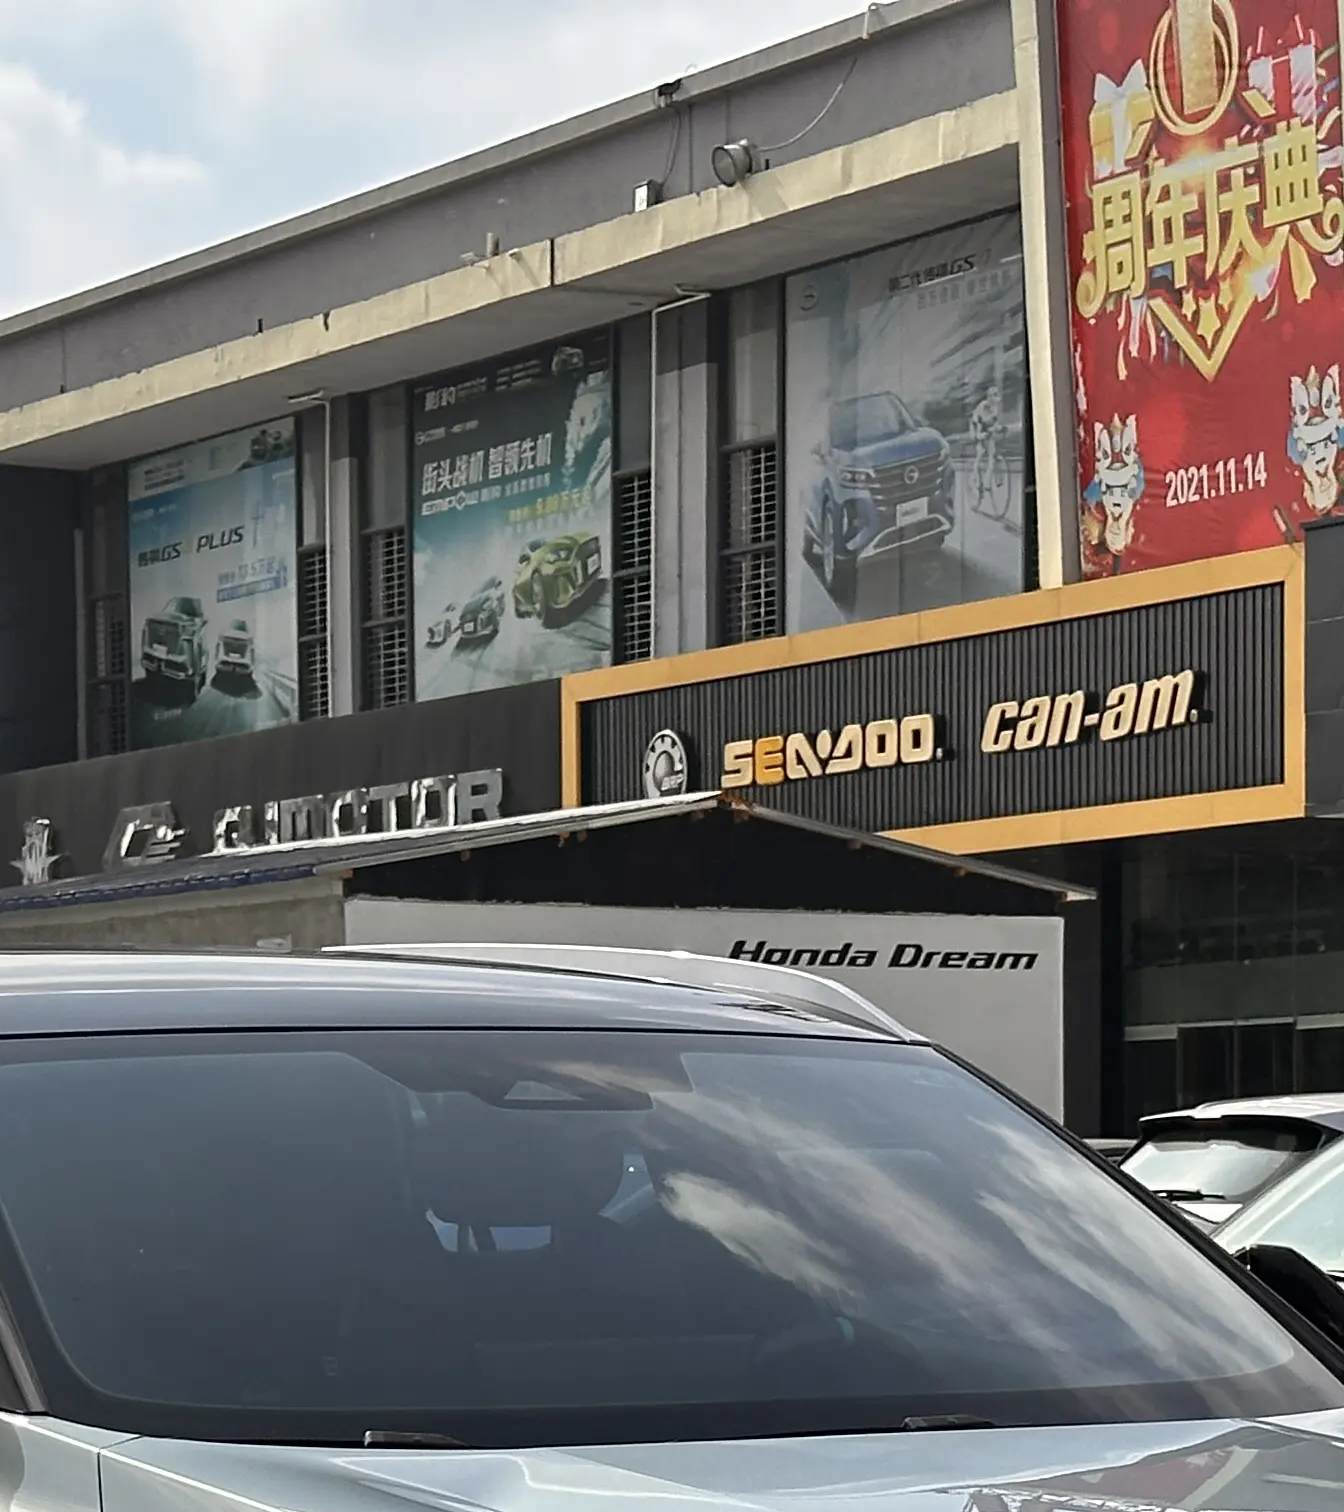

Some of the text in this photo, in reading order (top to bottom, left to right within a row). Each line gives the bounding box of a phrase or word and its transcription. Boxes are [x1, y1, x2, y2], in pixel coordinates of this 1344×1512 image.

[1080, 116, 1336, 315] 周年庆典
[421, 450, 485, 496] 街头战机
[1165, 451, 1267, 507] 2021.11.14
[196, 525, 245, 554] PLUS
[729, 940, 1039, 970] Honda Dream
